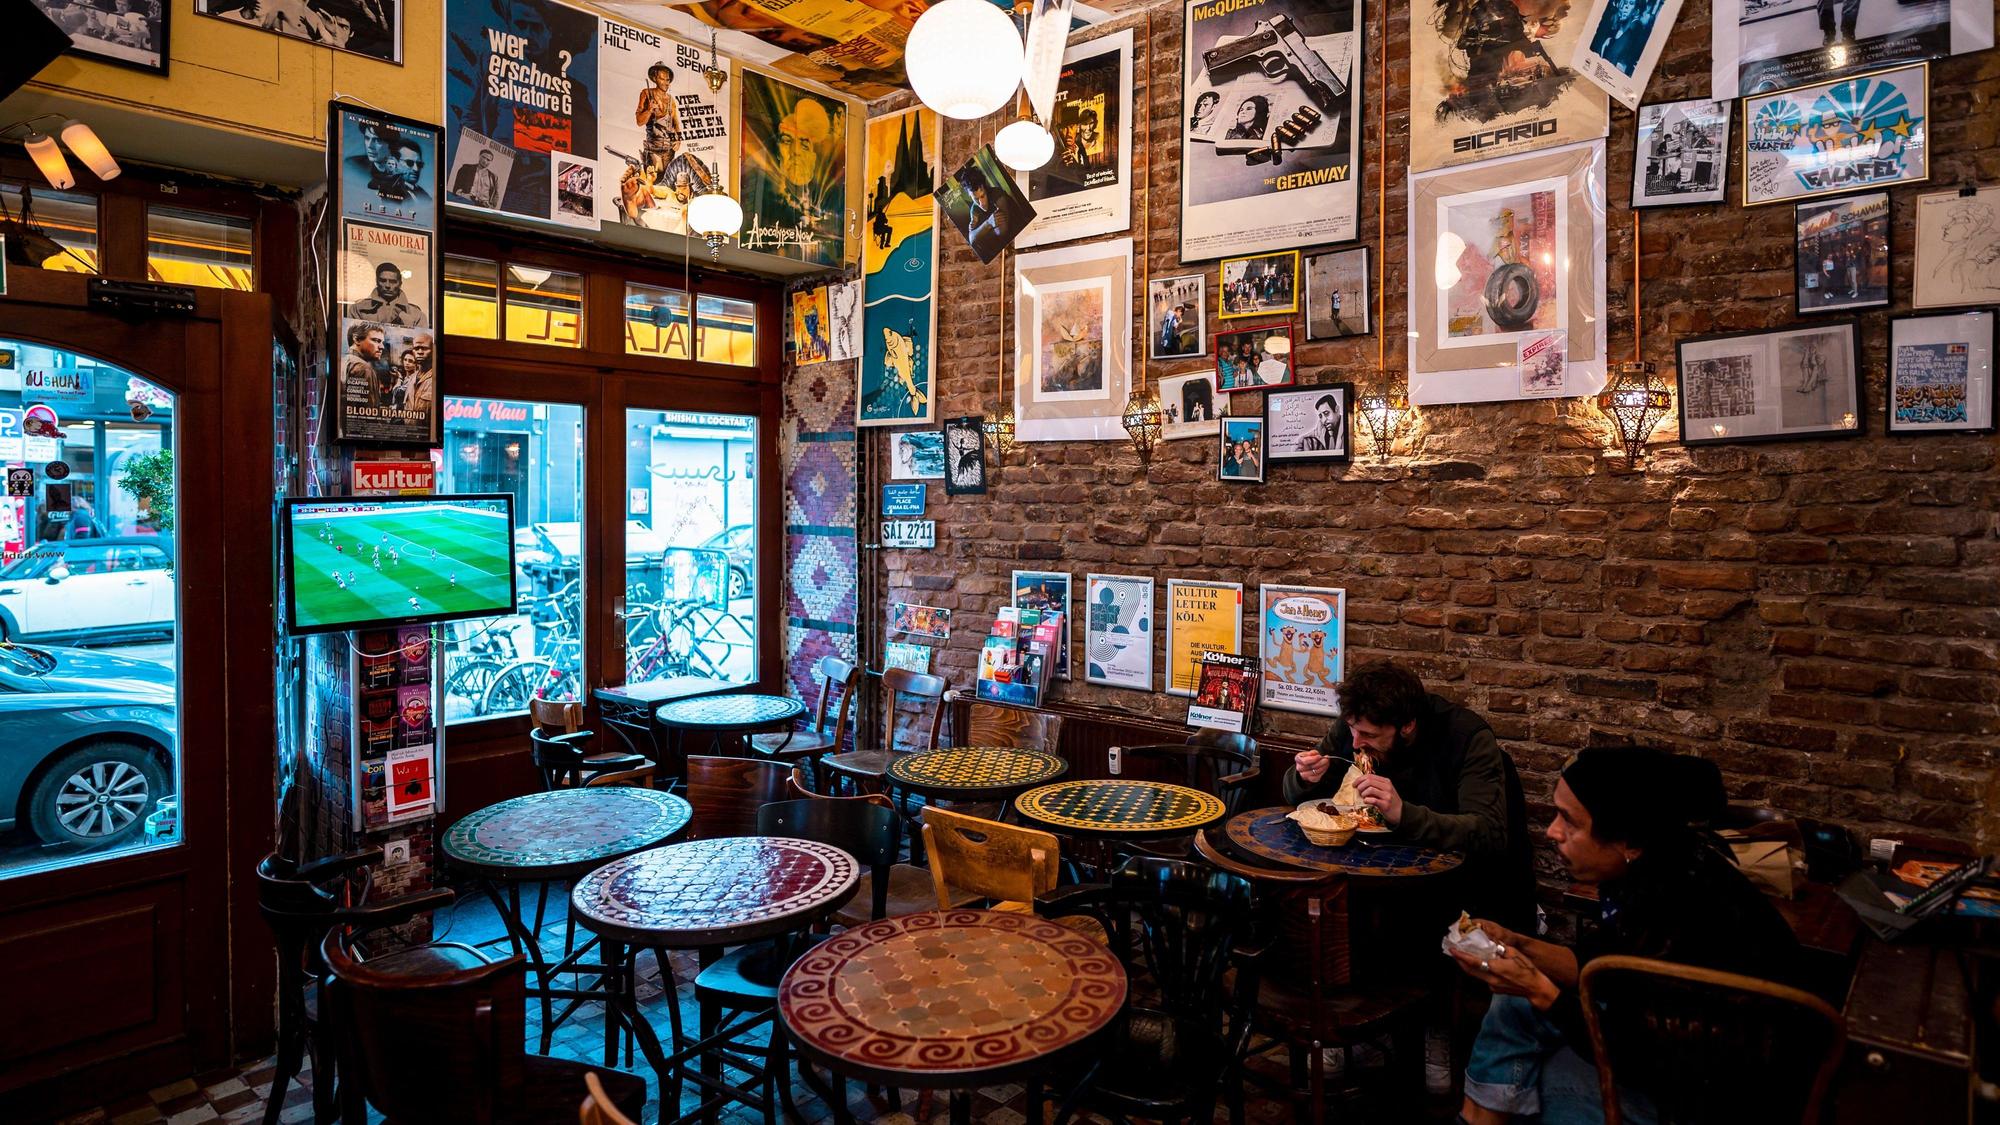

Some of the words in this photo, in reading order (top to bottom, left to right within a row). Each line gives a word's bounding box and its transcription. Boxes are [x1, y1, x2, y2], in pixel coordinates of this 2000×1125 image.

[604, 20, 661, 48] TERENCE
[488, 28, 529, 61] wer
[604, 34, 631, 52] HILL
[677, 44, 700, 60] BUD
[489, 54, 572, 95] erschoss
[677, 56, 727, 80] SPEN
[488, 75, 559, 111] Salvatore
[562, 94, 572, 115] G
[675, 94, 701, 105] VIER
[681, 116, 703, 129] FÜR
[667, 126, 727, 141] HALLELUJA
[1453, 118, 1558, 154] SICARIO
[1264, 178, 1275, 186] THE
[1276, 165, 1349, 191] GETAWAY
[1803, 160, 1898, 187] FALAFEL
[351, 227, 364, 241] LE
[747, 213, 795, 249] Apocalypse
[795, 221, 817, 243] Now
[346, 405, 378, 417] BLOOD
[382, 408, 426, 420] DIAMOND
[444, 400, 482, 421] Kebab
[488, 401, 527, 421] Haus
[665, 413, 697, 424] SHISHA
[707, 415, 748, 427] COCKTAIL
[355, 469, 432, 488] kultur
[907, 522, 933, 540] 2711
[1176, 587, 1218, 599] KULTUR
[1176, 600, 1217, 611] LETTER
[1176, 611, 1205, 623] KÖLN
[1201, 643, 1227, 651] KULTUR-
[1203, 651, 1244, 665] Kölner
[1294, 685, 1305, 693] Dez.
